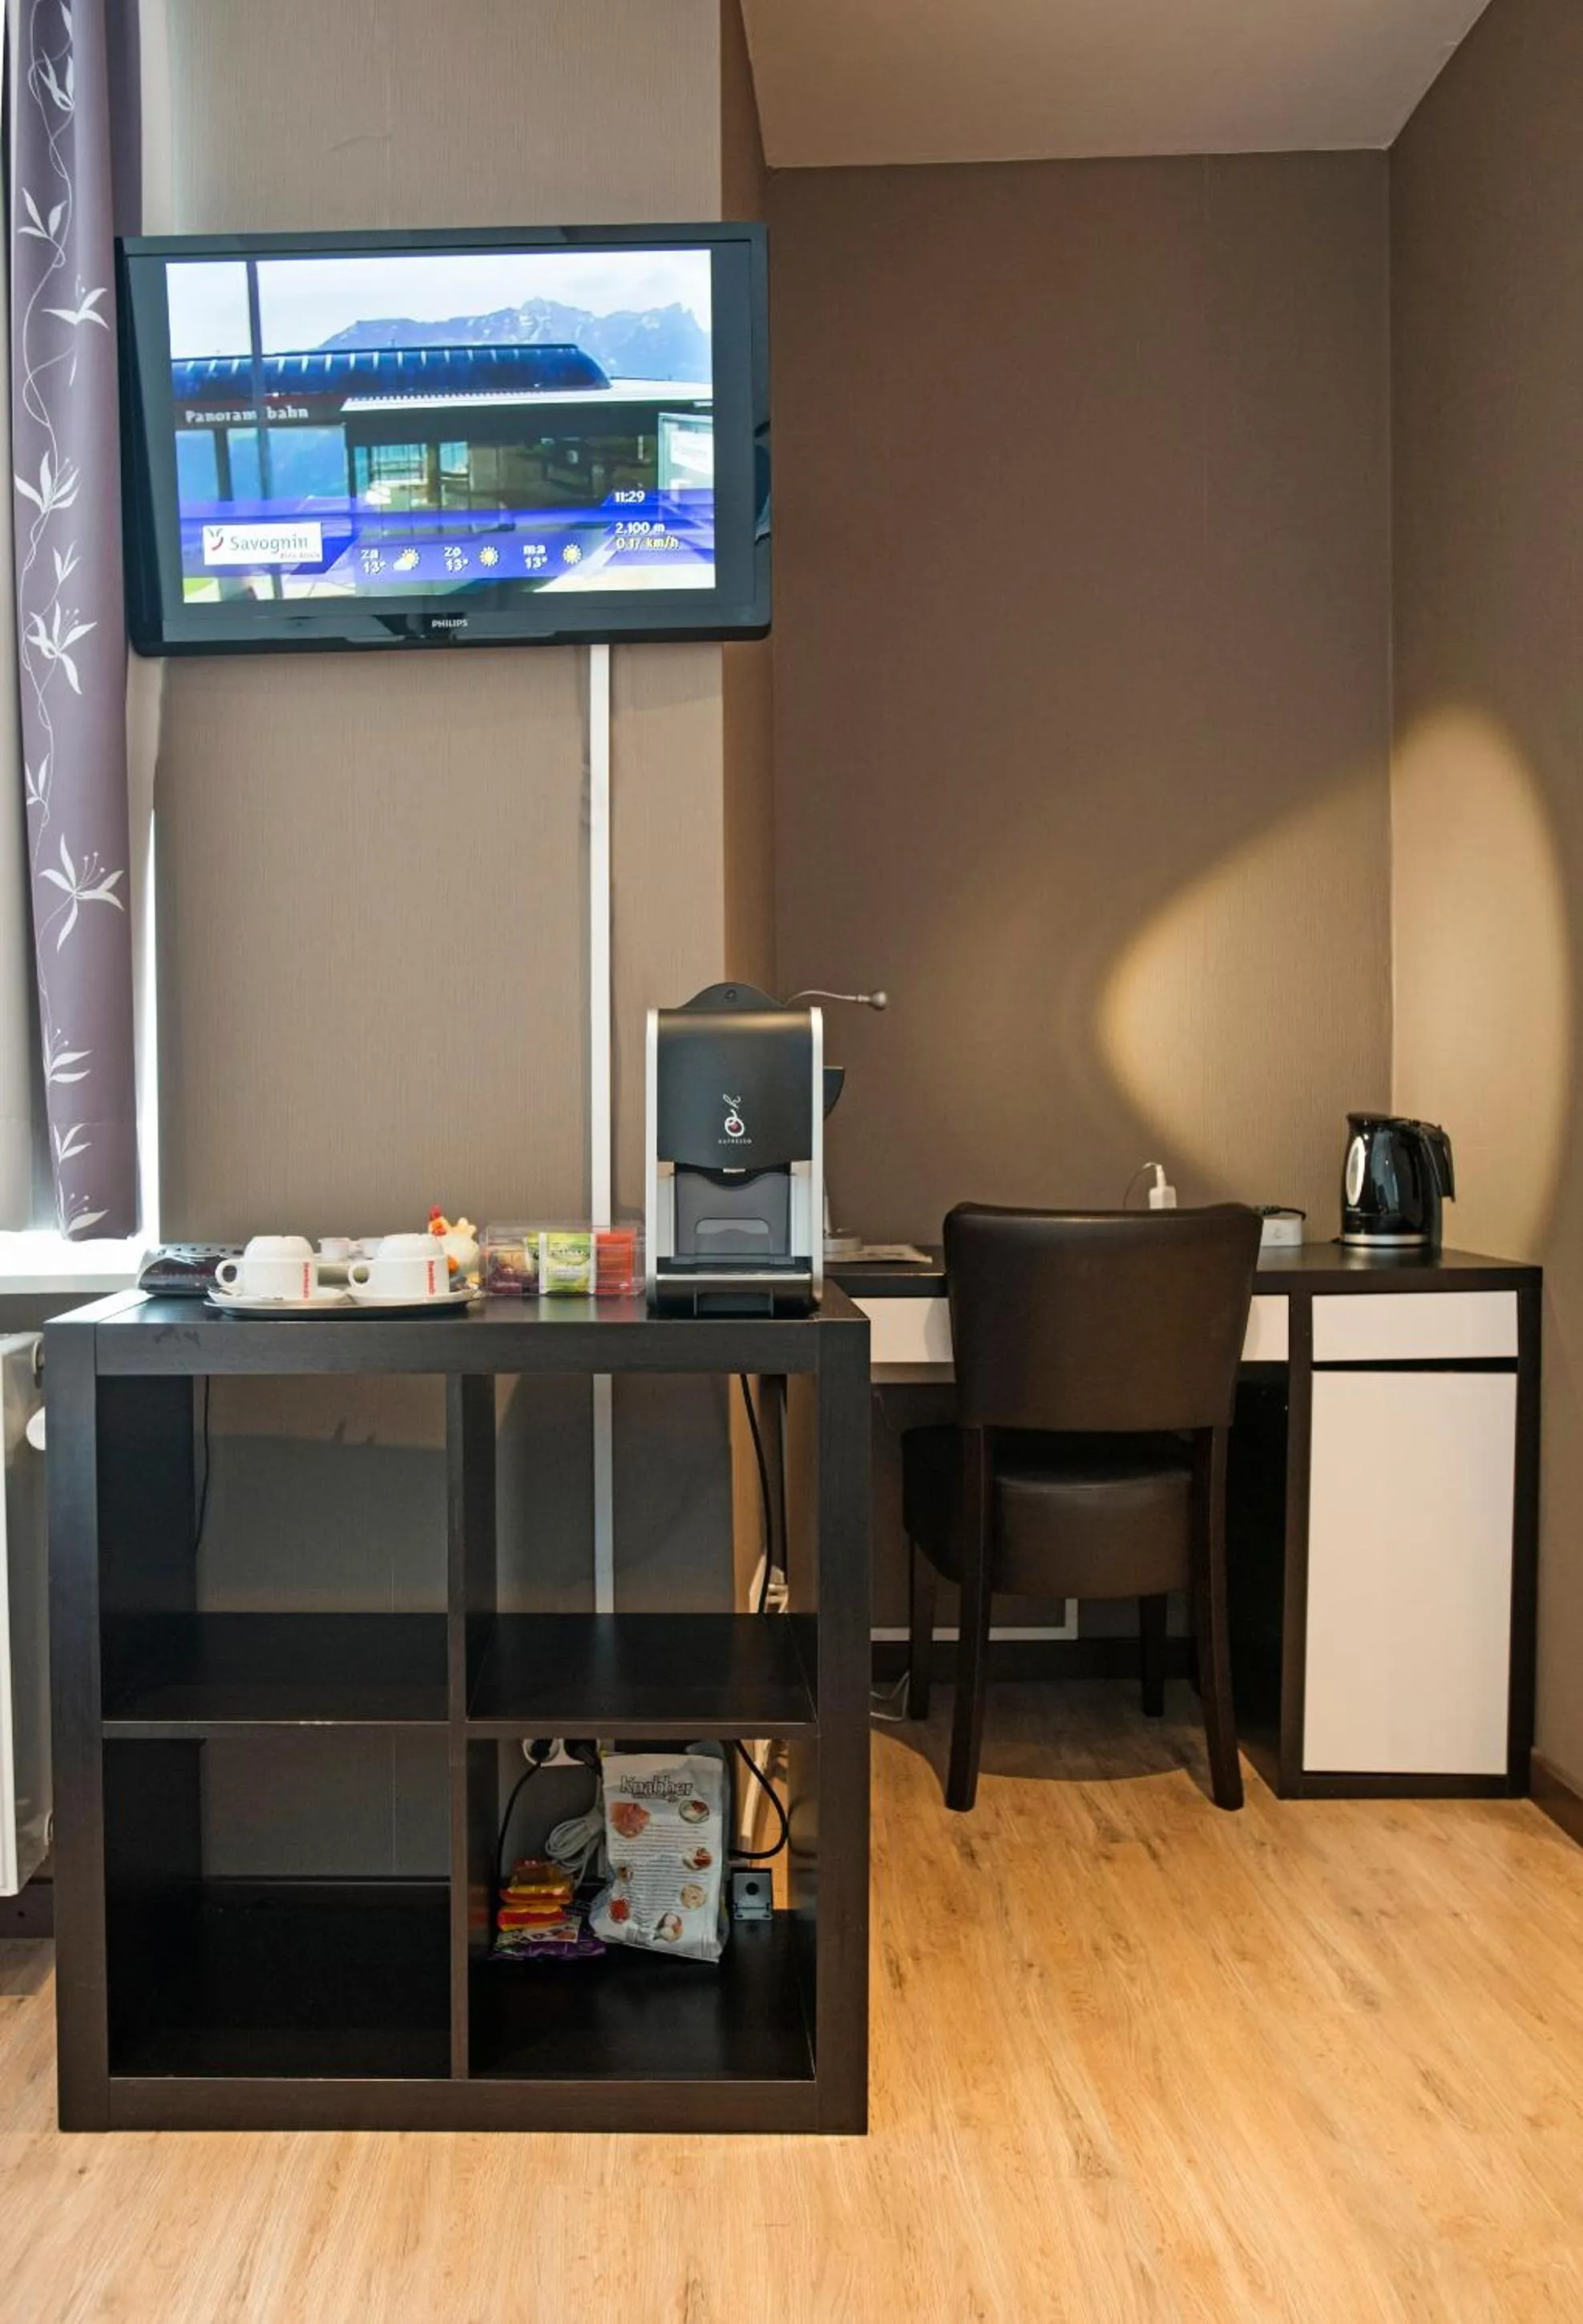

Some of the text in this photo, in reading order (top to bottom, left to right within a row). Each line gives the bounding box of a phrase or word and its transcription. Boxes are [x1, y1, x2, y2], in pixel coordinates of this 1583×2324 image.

[185, 405, 309, 423] Panorambahn
[615, 490, 645, 503] 11:29
[615, 521, 665, 535] 2.100 m
[230, 533, 309, 554] Savognin
[647, 535, 679, 548] km/h
[523, 544, 546, 556] ma
[431, 619, 468, 628] PHILIPS
[620, 1773, 694, 1797] Knabber
